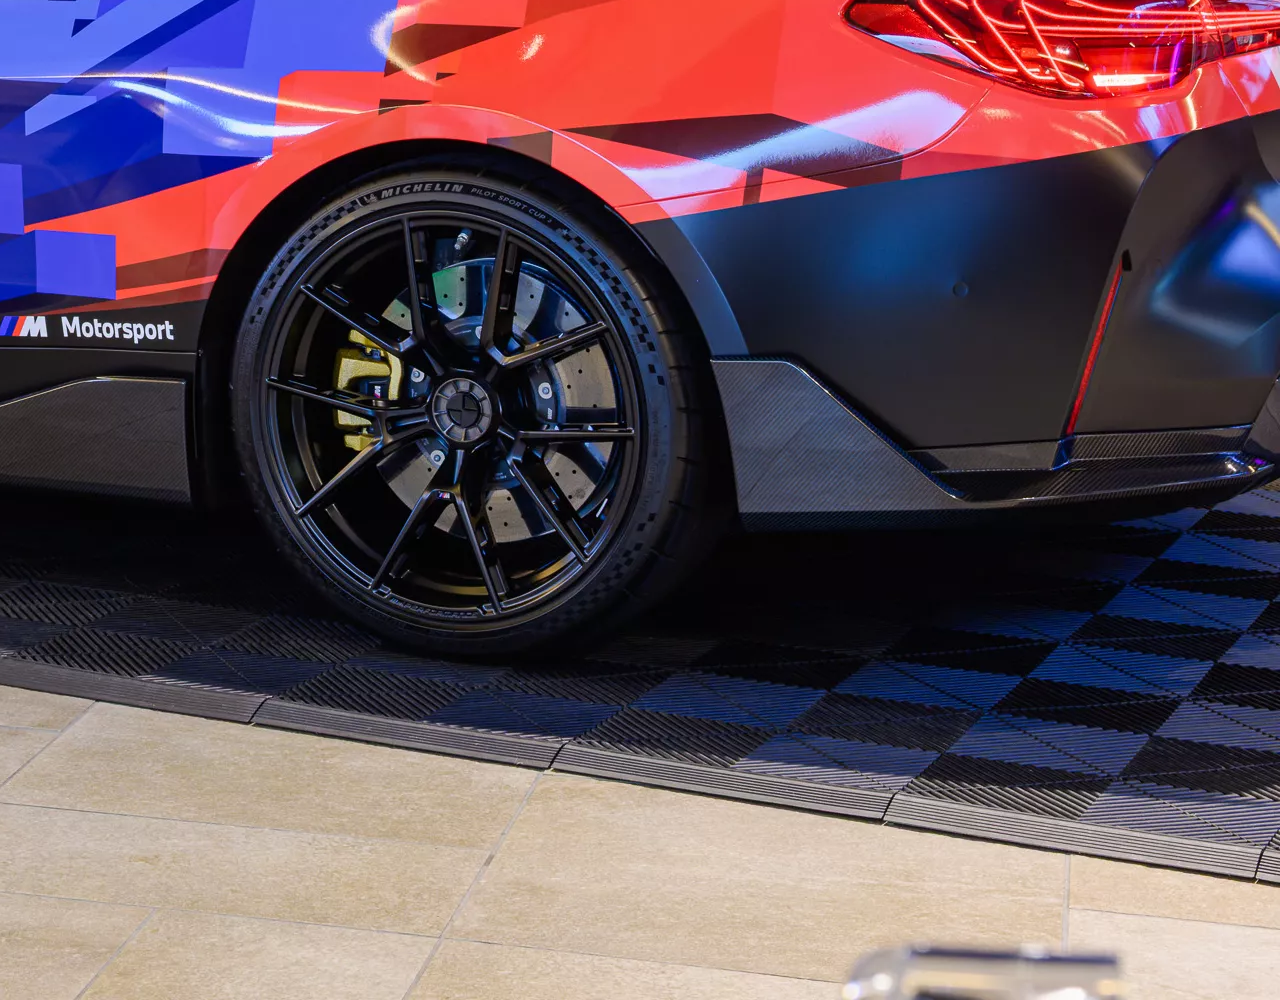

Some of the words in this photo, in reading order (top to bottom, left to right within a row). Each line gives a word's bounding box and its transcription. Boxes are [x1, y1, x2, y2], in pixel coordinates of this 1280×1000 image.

[381, 183, 464, 199] MICHELIN
[470, 187, 496, 198] PILOT
[497, 195, 527, 211] SPORT
[528, 208, 547, 221] CUP
[61, 316, 175, 343] Motorsport
